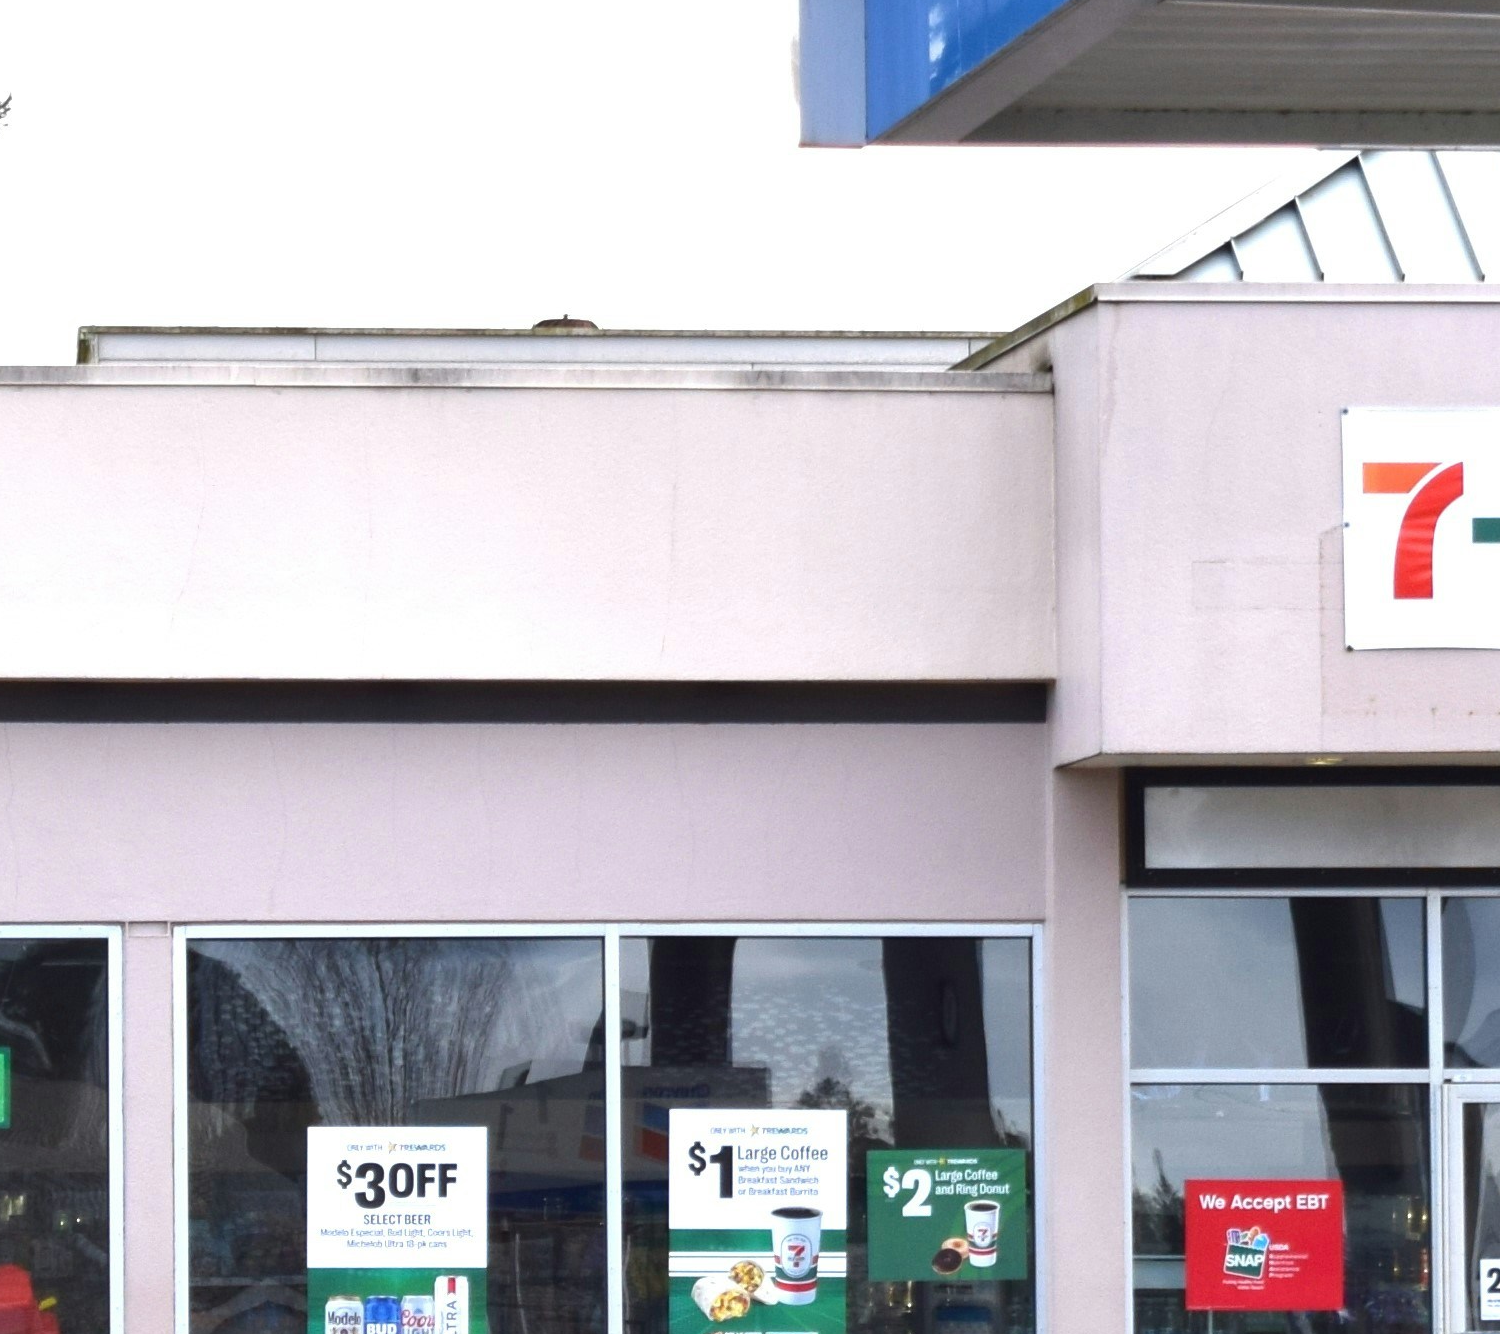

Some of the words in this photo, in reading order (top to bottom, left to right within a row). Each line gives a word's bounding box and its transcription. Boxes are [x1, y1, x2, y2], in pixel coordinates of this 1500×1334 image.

[737, 1145, 777, 1163] Large
[781, 1145, 828, 1161] Coffee
[688, 1141, 733, 1199] $1
[762, 1166, 776, 1174] you
[935, 1170, 963, 1183] Large
[965, 1169, 998, 1181] Coffee
[388, 1162, 458, 1198] OFF
[738, 1176, 777, 1184] Breakfast
[780, 1176, 819, 1184] Sandwich
[883, 1167, 932, 1217] $2
[935, 1184, 954, 1195] and
[956, 1183, 978, 1197] Ring
[980, 1183, 1010, 1195] Donut
[1199, 1194, 1225, 1210] We
[1231, 1194, 1291, 1214] Accept
[1296, 1194, 1329, 1210] EBT
[364, 1214, 401, 1225] SELECT
[404, 1214, 431, 1225] BEER
[1225, 1254, 1264, 1267] SNAP
[328, 1311, 361, 1325] Modelo
